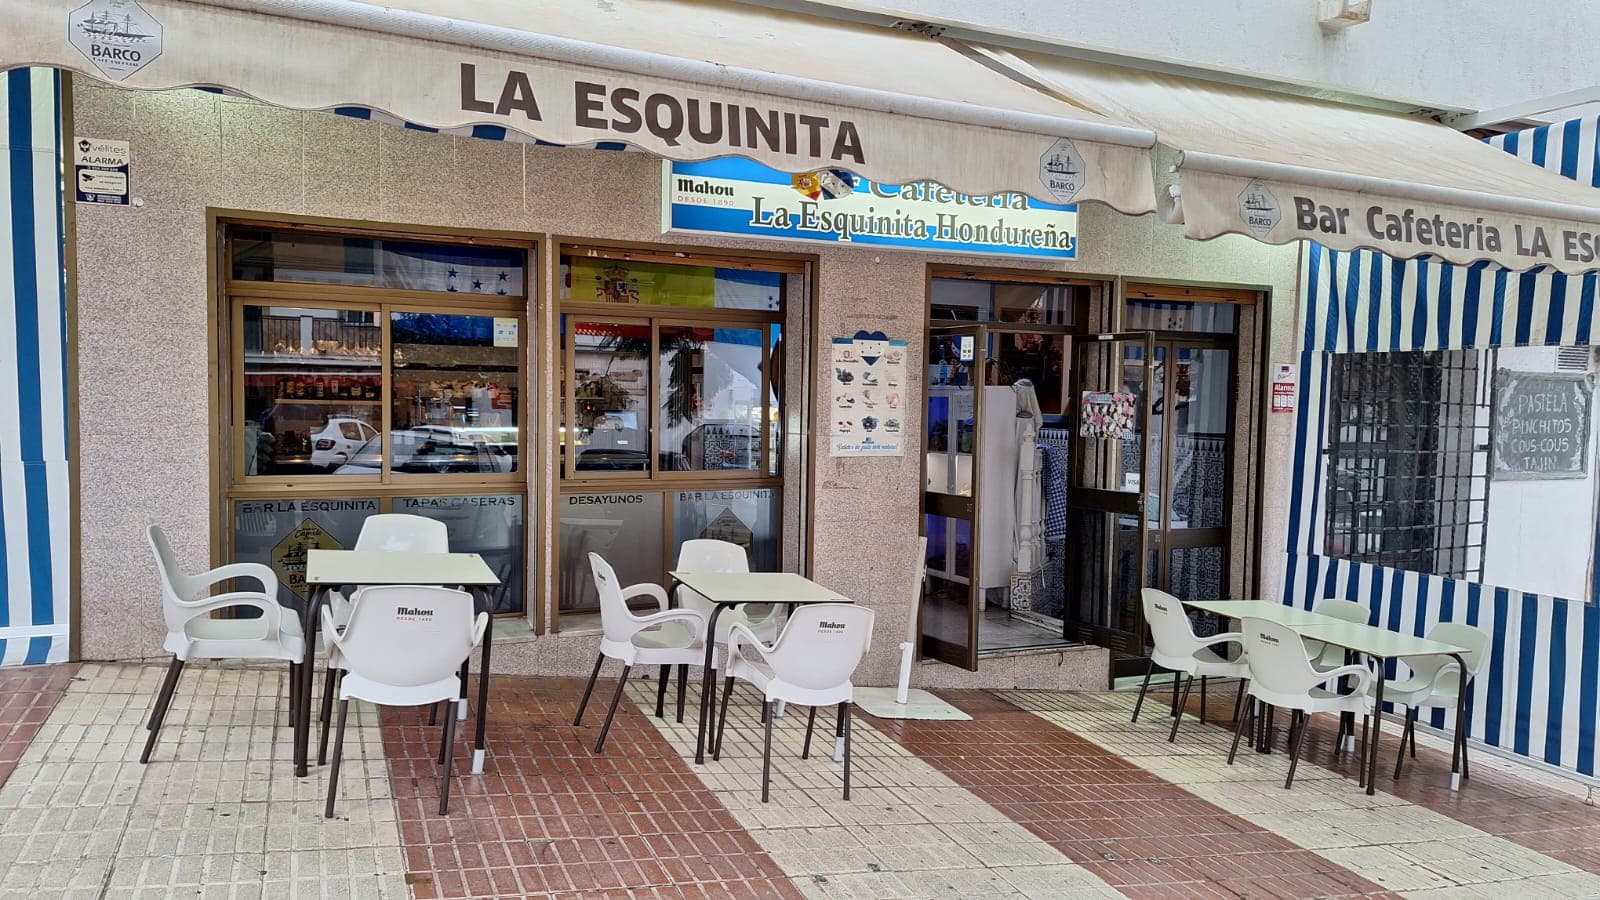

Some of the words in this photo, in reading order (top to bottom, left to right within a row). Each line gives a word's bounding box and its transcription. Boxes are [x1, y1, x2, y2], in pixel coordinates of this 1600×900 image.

[91, 44, 141, 62] BARCO
[460, 62, 542, 122] LA
[574, 80, 866, 164] ESQUINITA
[81, 156, 123, 165] ALARMA
[677, 178, 734, 196] Mahou
[1050, 179, 1075, 191] BARCO
[751, 195, 791, 228] La
[797, 200, 928, 240] Esquinita
[935, 212, 1072, 250] Hondureña
[1248, 216, 1272, 226] BARCO
[1294, 196, 1350, 235] Bar
[1366, 205, 1502, 252] Cafetería
[1514, 223, 1553, 259] LA
[1518, 393, 1568, 413] PASTELA
[1512, 418, 1572, 435] PINCHITOS
[1511, 437, 1569, 453] COUS-COUS
[569, 494, 643, 505] DESAYUNOS
[680, 492, 702, 502] BAR
[277, 503, 297, 513] LA
[301, 500, 377, 512] ESQUINITA
[397, 607, 434, 616] Mahou
[819, 621, 846, 629] Mahou
